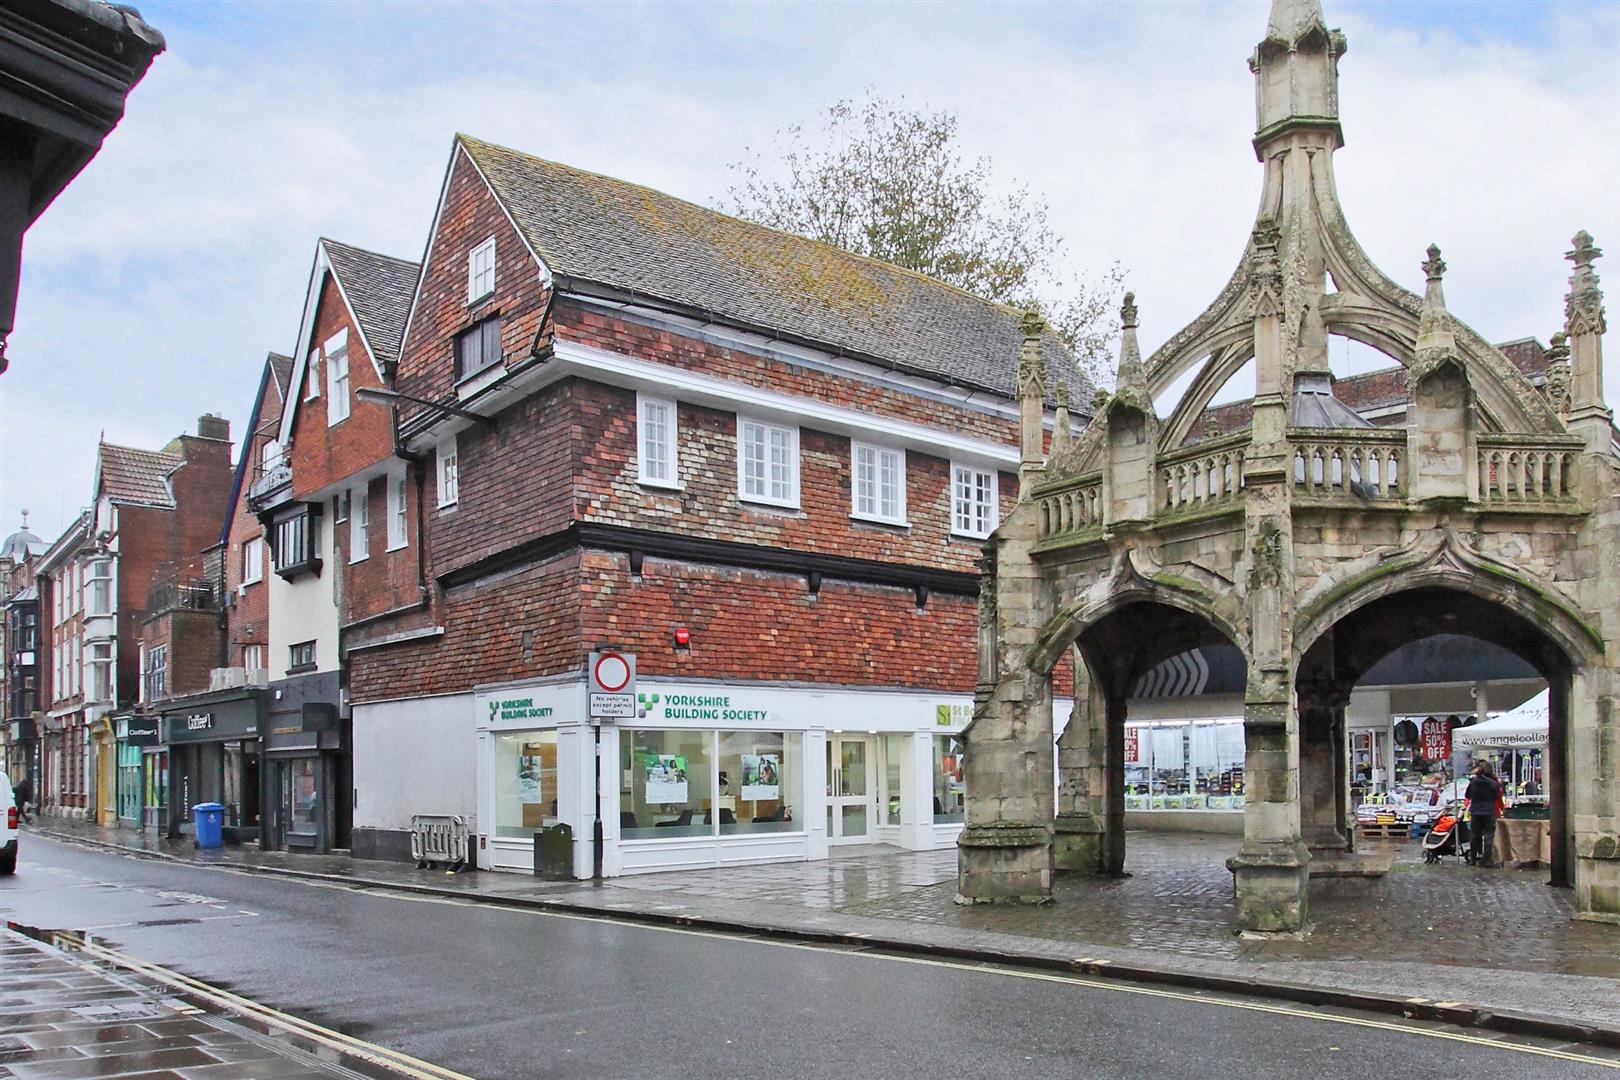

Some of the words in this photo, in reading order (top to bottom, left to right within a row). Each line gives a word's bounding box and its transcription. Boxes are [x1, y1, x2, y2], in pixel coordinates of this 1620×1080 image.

[500, 698, 533, 709] YORKSHIRE
[665, 695, 729, 707] YORKSHIRE
[501, 709, 527, 720] BUILDING
[528, 707, 552, 718] SOCIETY
[665, 707, 718, 719] BUILDING
[722, 709, 767, 721] SOCIETY
[1424, 721, 1447, 735] SALE
[1425, 735, 1447, 747] 50%
[1427, 746, 1445, 759] OFF
